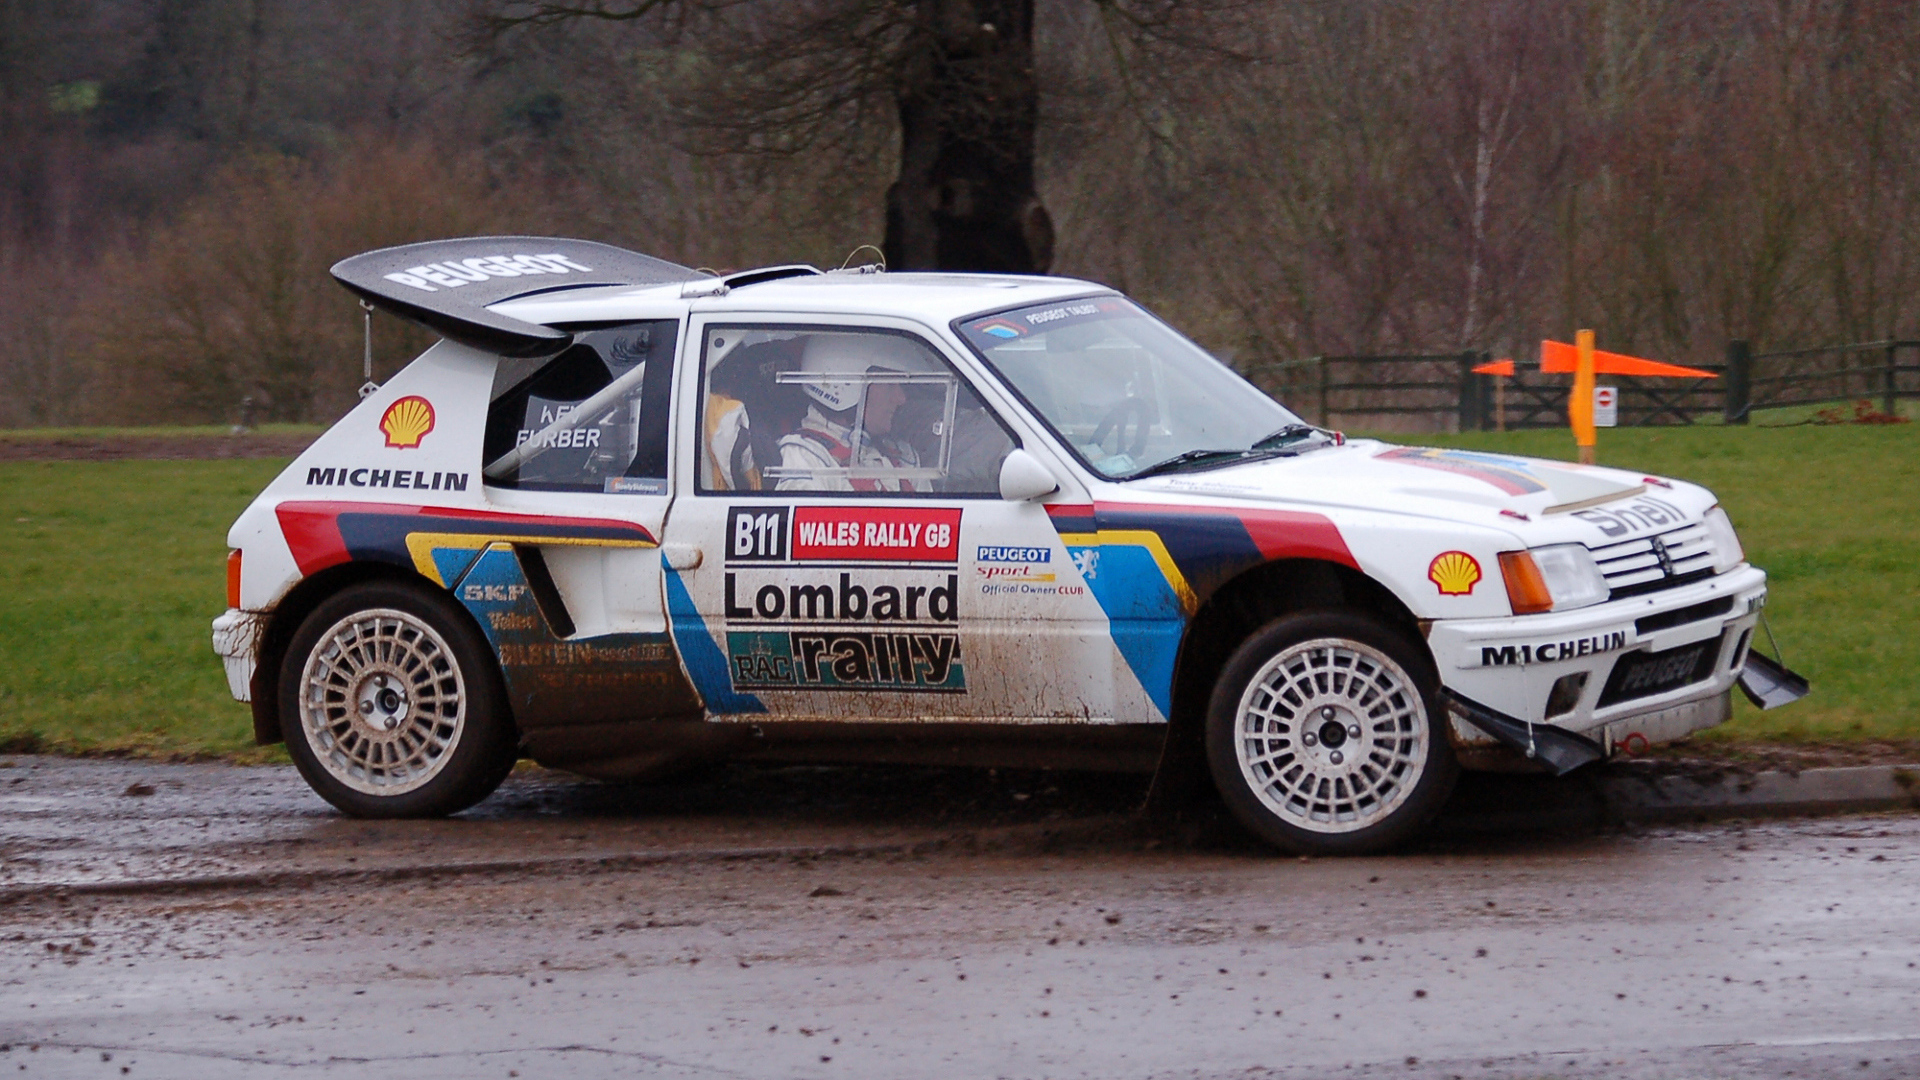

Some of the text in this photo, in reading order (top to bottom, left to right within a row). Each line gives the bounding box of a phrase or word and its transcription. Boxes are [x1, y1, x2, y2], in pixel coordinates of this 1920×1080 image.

[384, 254, 593, 292] PEUGEOT
[1026, 307, 1069, 325] PEUGEOT
[1066, 304, 1100, 317] TALBOT
[516, 428, 601, 448] FURBER
[306, 467, 469, 492] MICHELIN
[1571, 496, 1688, 538] Shell
[734, 513, 780, 556] B11
[799, 522, 951, 548] WALES RALLY GB
[979, 548, 1048, 562] PEUGEOT
[976, 565, 1032, 579] sport
[464, 585, 528, 601] SKF
[724, 572, 958, 621] Lombard
[982, 584, 1084, 595] Official Owners CLUB
[798, 634, 956, 685] rally
[1481, 631, 1626, 666] MICHELIN
[734, 655, 792, 682] RAC
[1621, 647, 1704, 691] PEUGEOT
